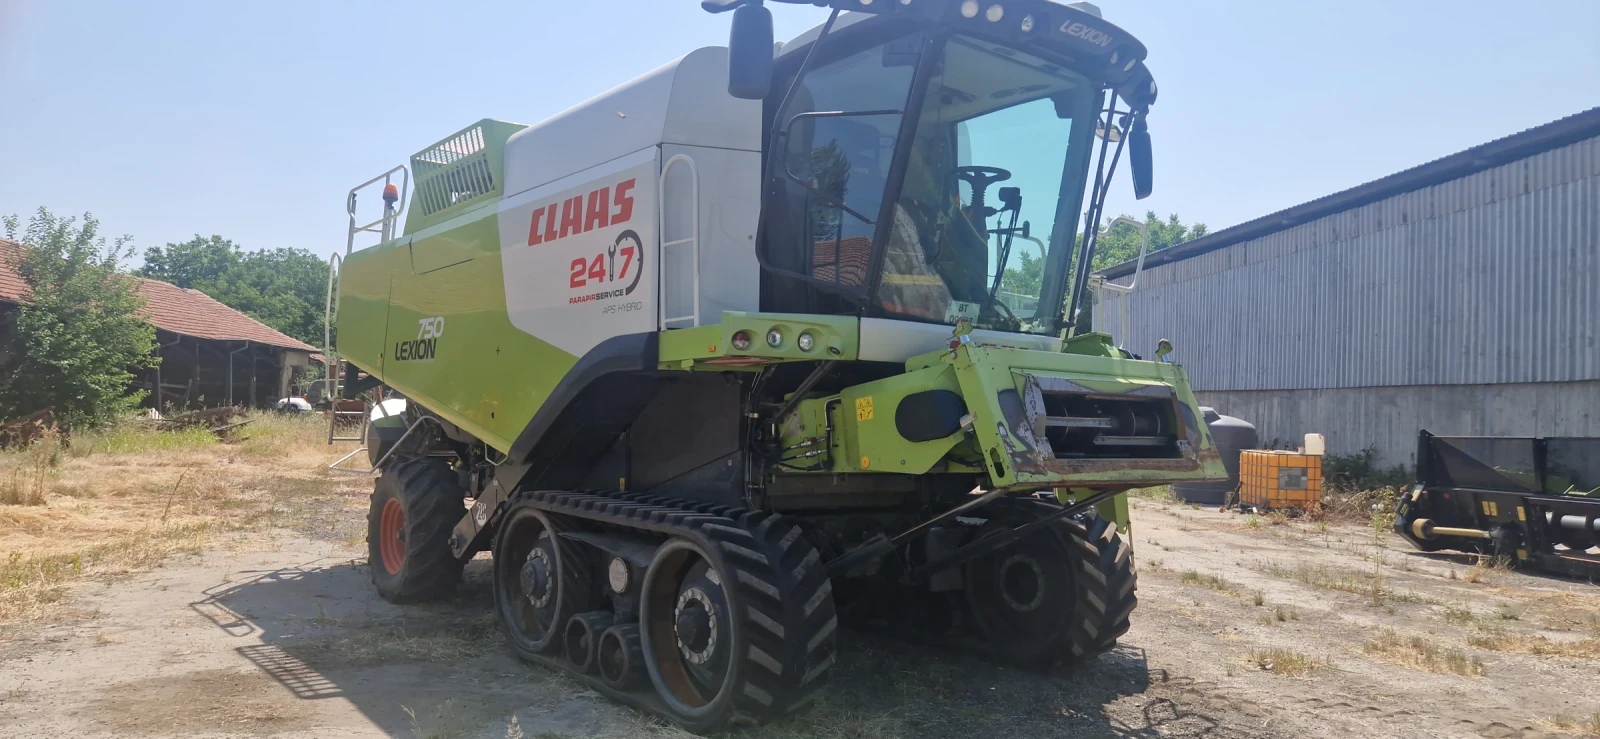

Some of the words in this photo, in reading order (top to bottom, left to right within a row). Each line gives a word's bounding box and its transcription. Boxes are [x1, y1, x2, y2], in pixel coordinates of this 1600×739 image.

[1060, 20, 1112, 47] LEXION
[528, 178, 636, 247] CLAAS
[569, 288, 624, 305] PARAPIRSERVICE
[602, 304, 616, 315] APS
[617, 301, 643, 312] HYBRID
[958, 304, 969, 313] BT
[417, 316, 444, 340] 750
[395, 338, 437, 361] LEXION
